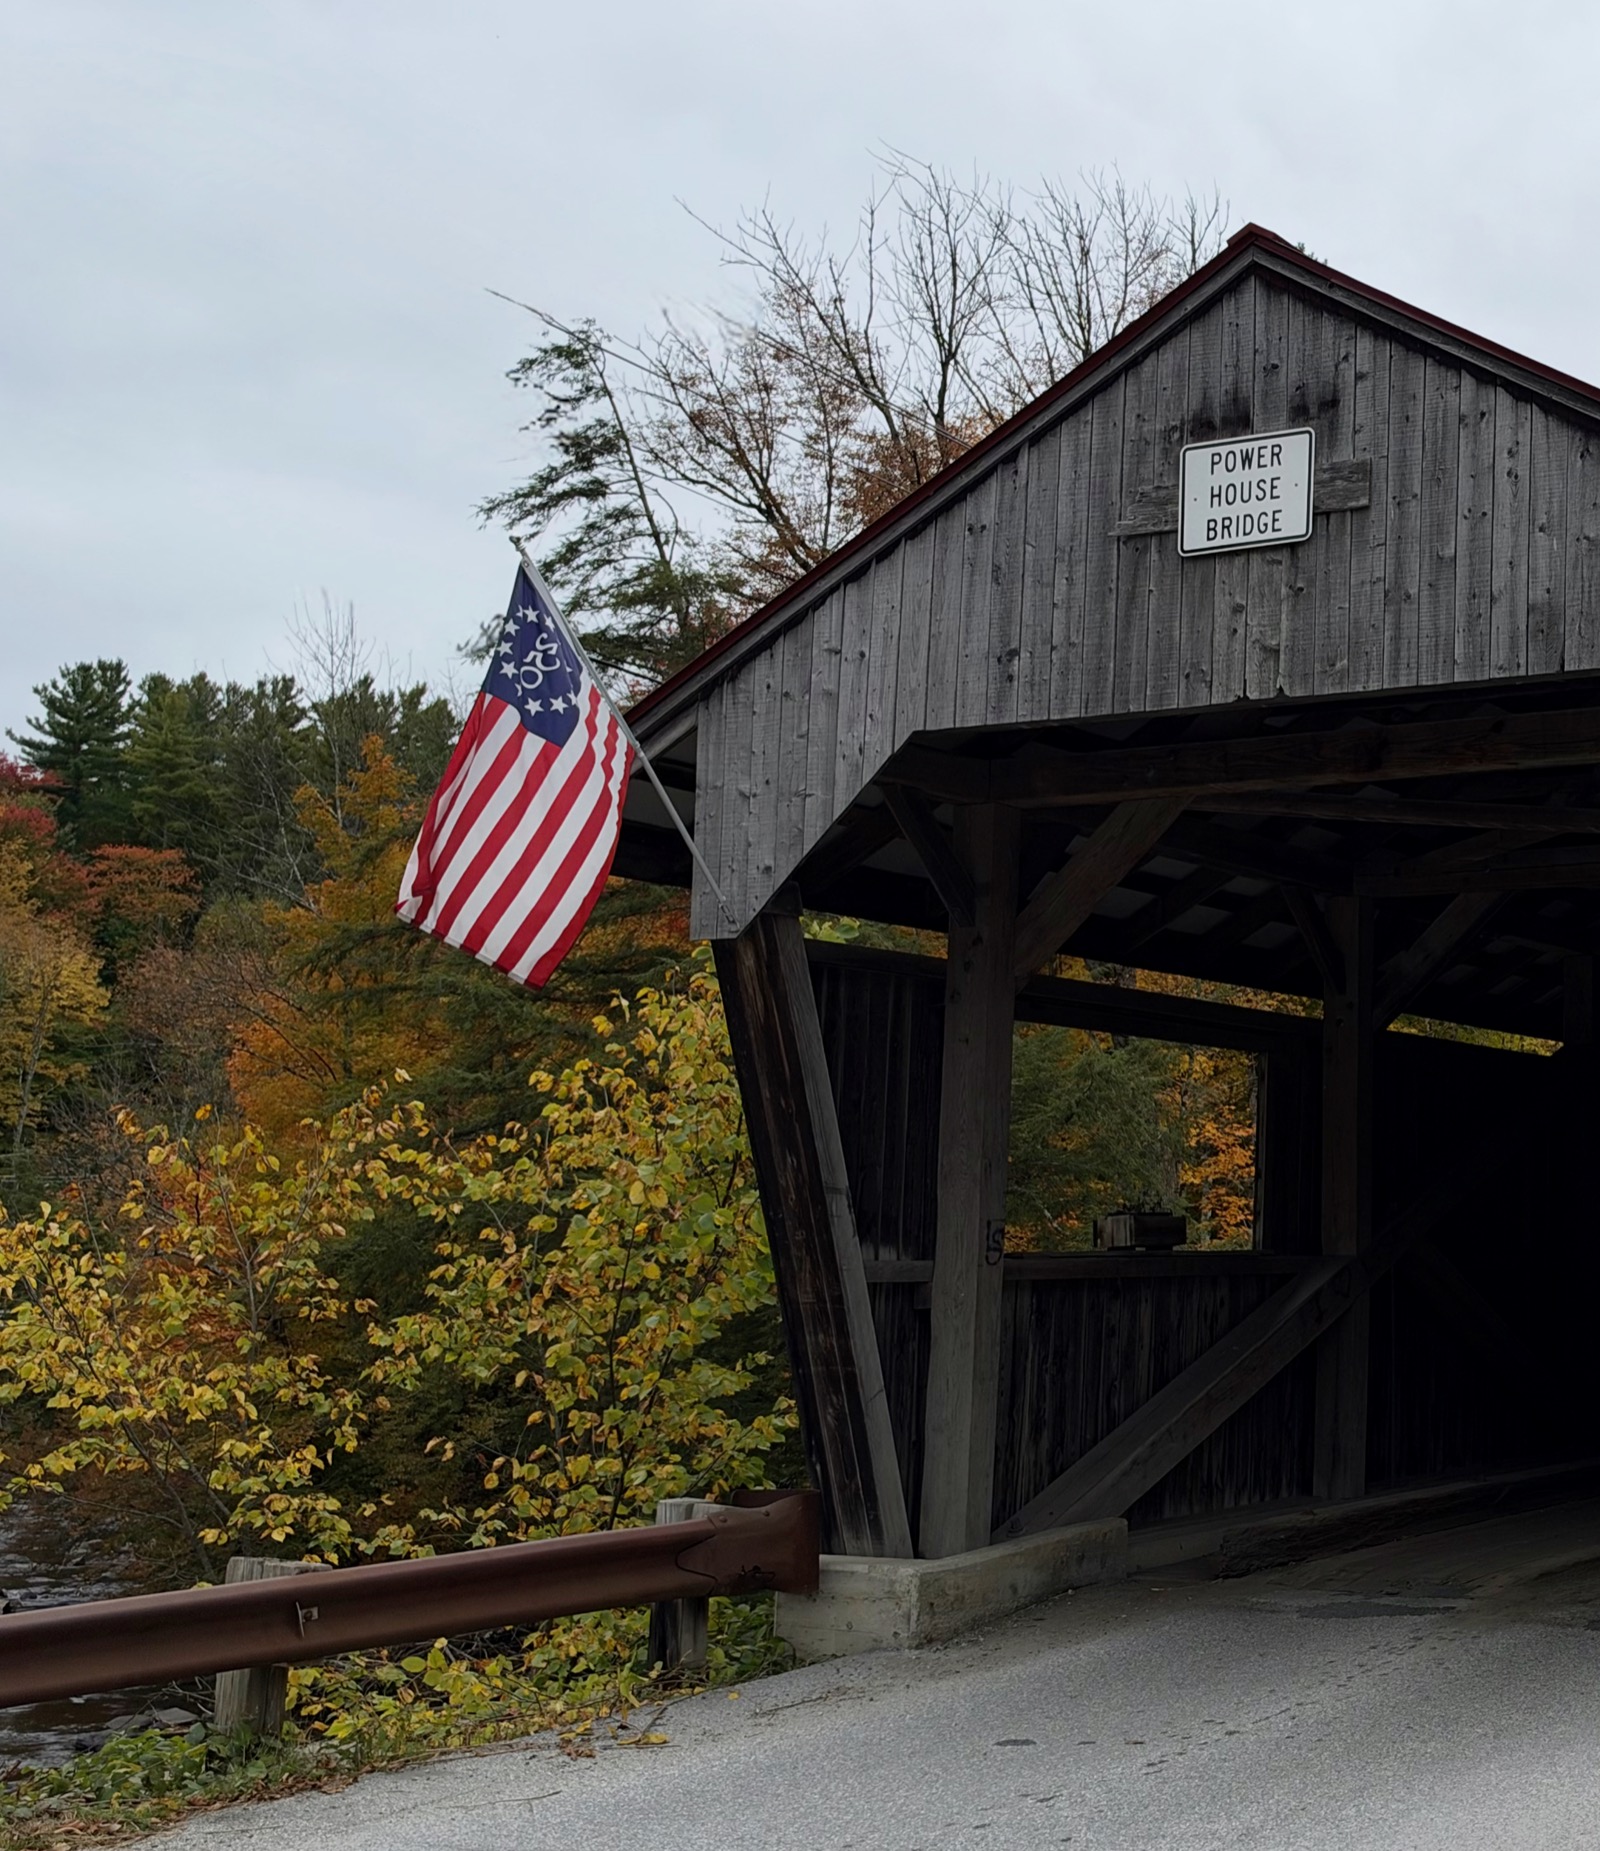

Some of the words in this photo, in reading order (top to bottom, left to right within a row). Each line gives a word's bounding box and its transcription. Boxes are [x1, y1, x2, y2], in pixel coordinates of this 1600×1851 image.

[1210, 443, 1283, 476] POWER
[1209, 476, 1282, 509] HOUSE
[1205, 509, 1283, 542] BRIDGE
